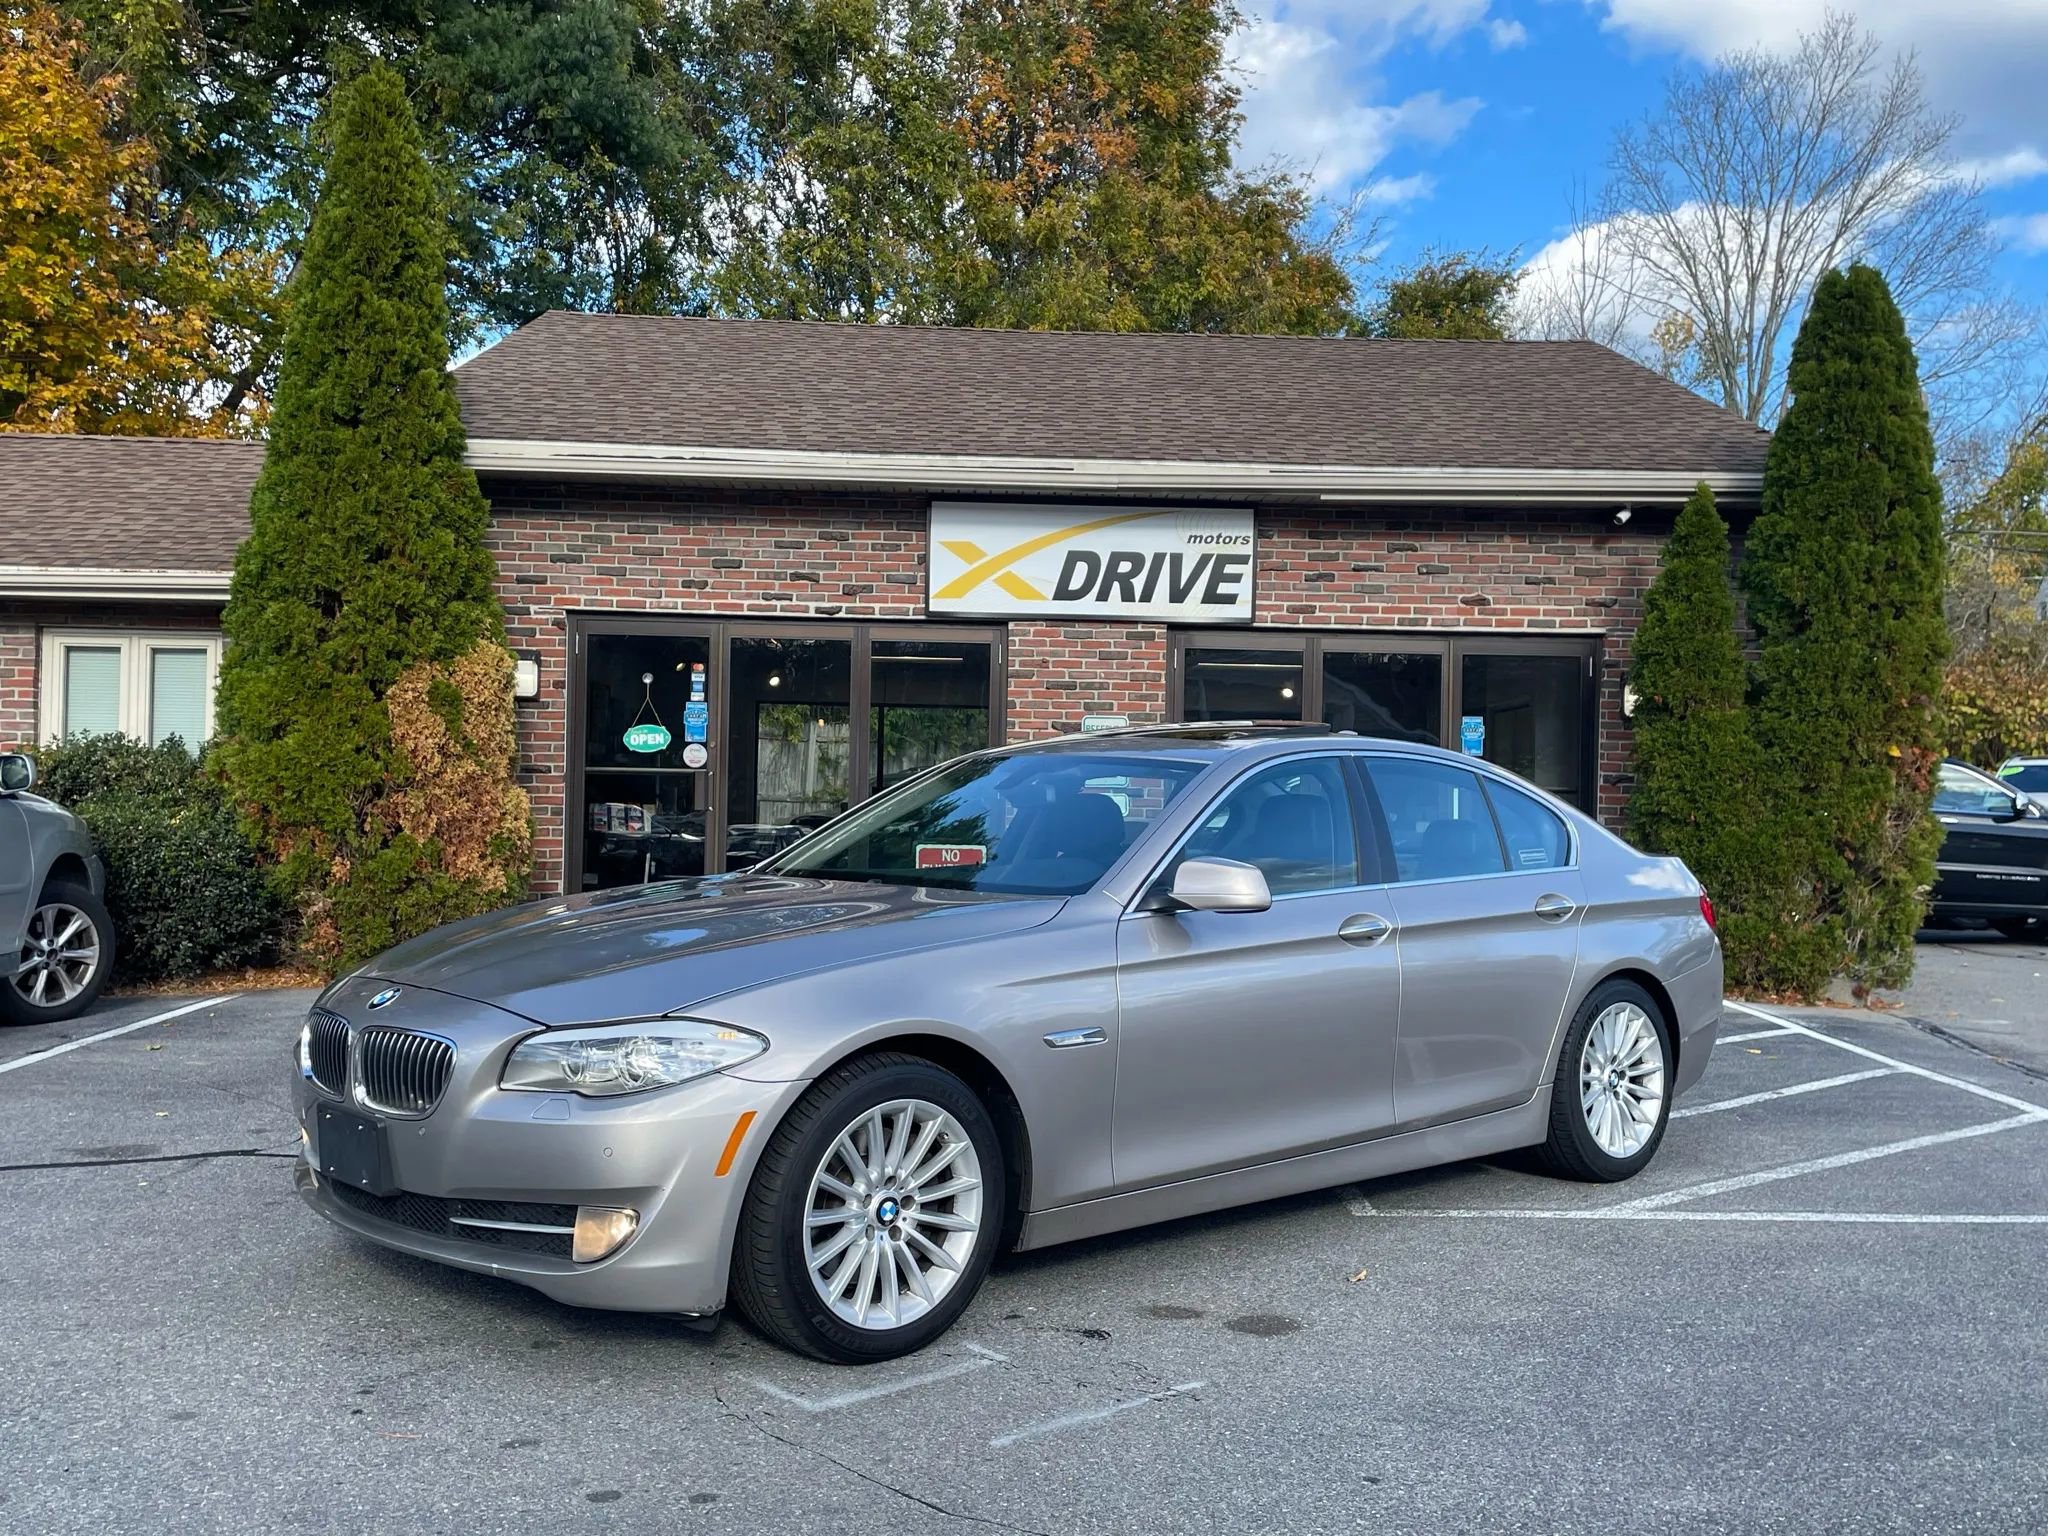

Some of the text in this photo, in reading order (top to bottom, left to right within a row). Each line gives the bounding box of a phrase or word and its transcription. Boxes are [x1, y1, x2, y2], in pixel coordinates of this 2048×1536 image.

[1187, 532, 1251, 545] motors
[1052, 550, 1252, 605] DRIVE
[630, 733, 665, 745] OPEN
[942, 849, 960, 862] NO
